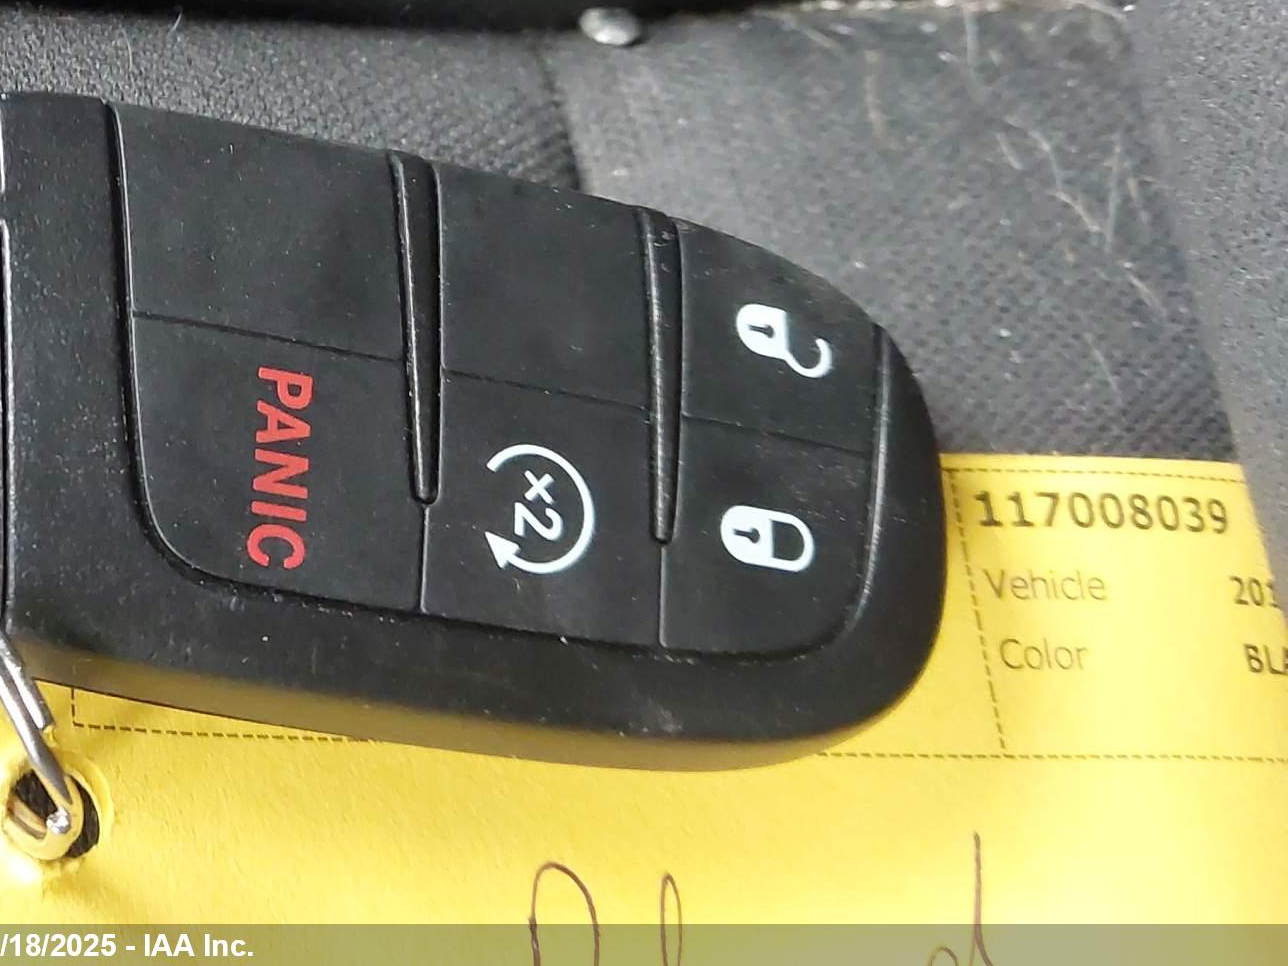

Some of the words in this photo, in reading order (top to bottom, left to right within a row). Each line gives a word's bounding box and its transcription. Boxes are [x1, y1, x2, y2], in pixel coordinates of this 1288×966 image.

[246, 366, 313, 570] PANIC
[974, 490, 1228, 534] 117008039
[982, 569, 1107, 601] Vehicle
[999, 638, 1088, 670] Color
